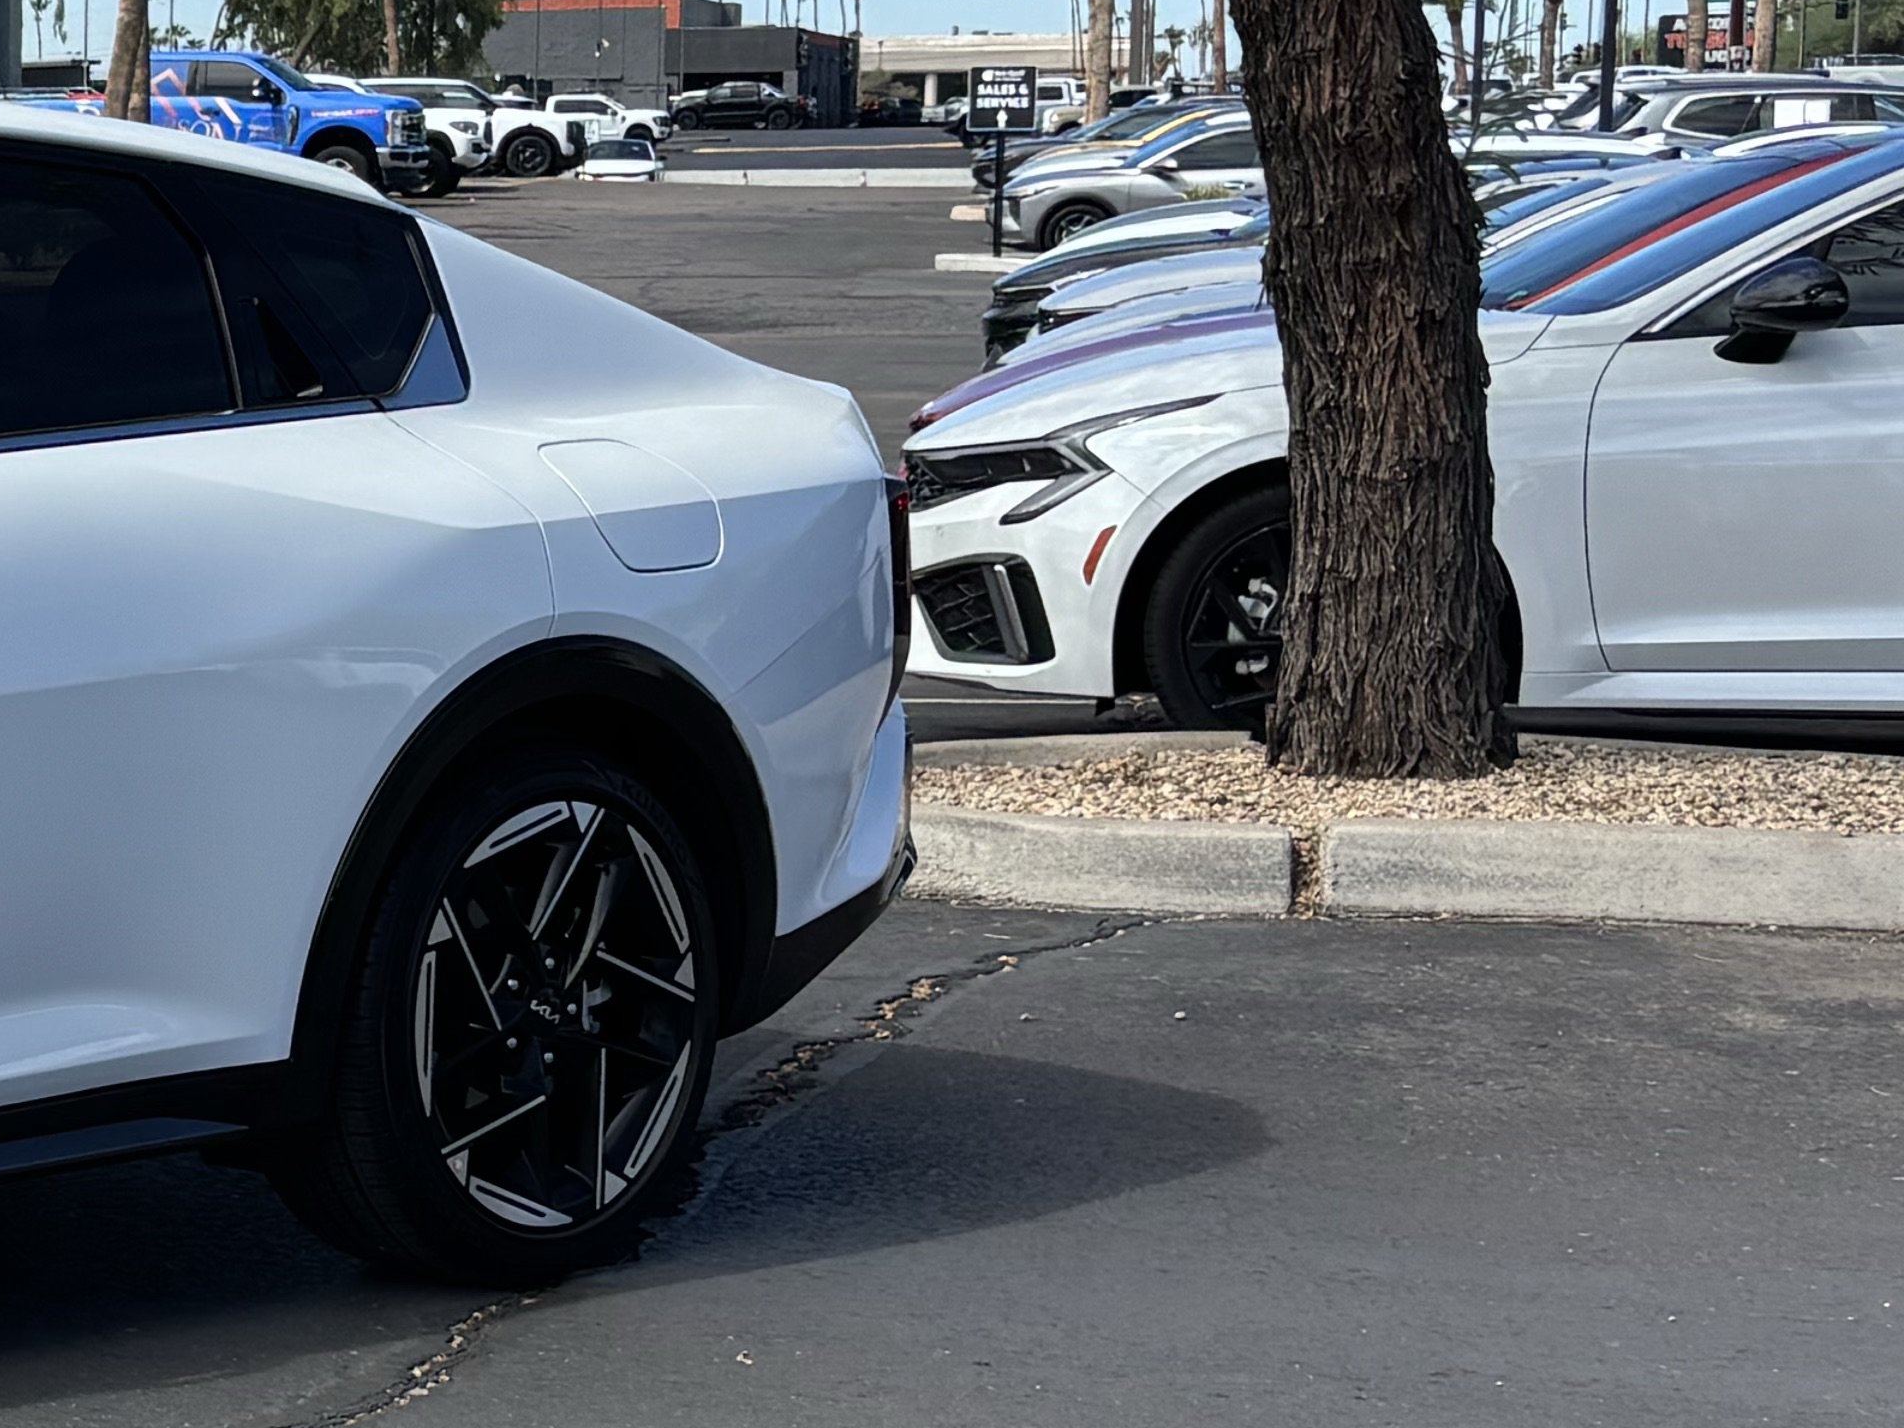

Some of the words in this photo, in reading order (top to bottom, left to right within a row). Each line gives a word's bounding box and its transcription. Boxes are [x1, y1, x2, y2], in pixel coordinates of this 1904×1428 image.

[977, 83, 1016, 96] SALES
[976, 96, 1029, 109] SERVICE
[530, 999, 560, 1024] KIA
